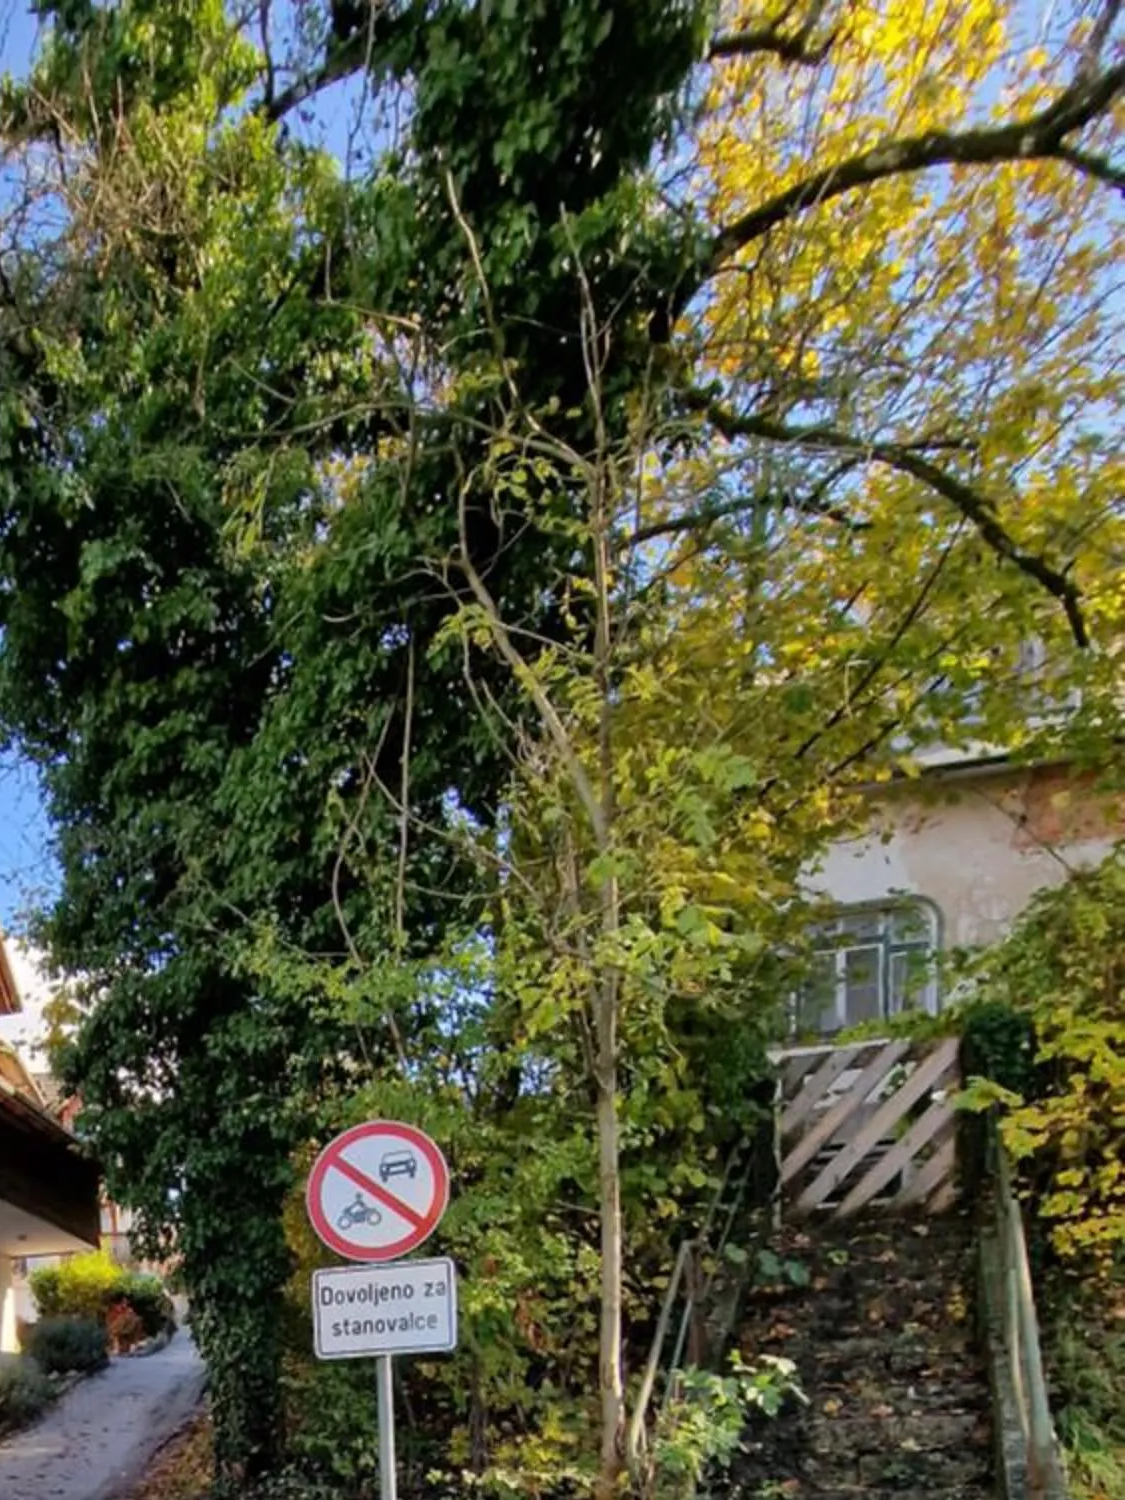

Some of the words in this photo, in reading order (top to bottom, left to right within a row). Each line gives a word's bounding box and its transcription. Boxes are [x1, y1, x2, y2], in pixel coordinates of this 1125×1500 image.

[321, 1283, 414, 1306] Dovoljeno
[424, 1281, 446, 1297] za
[332, 1312, 438, 1337] stanovalce
